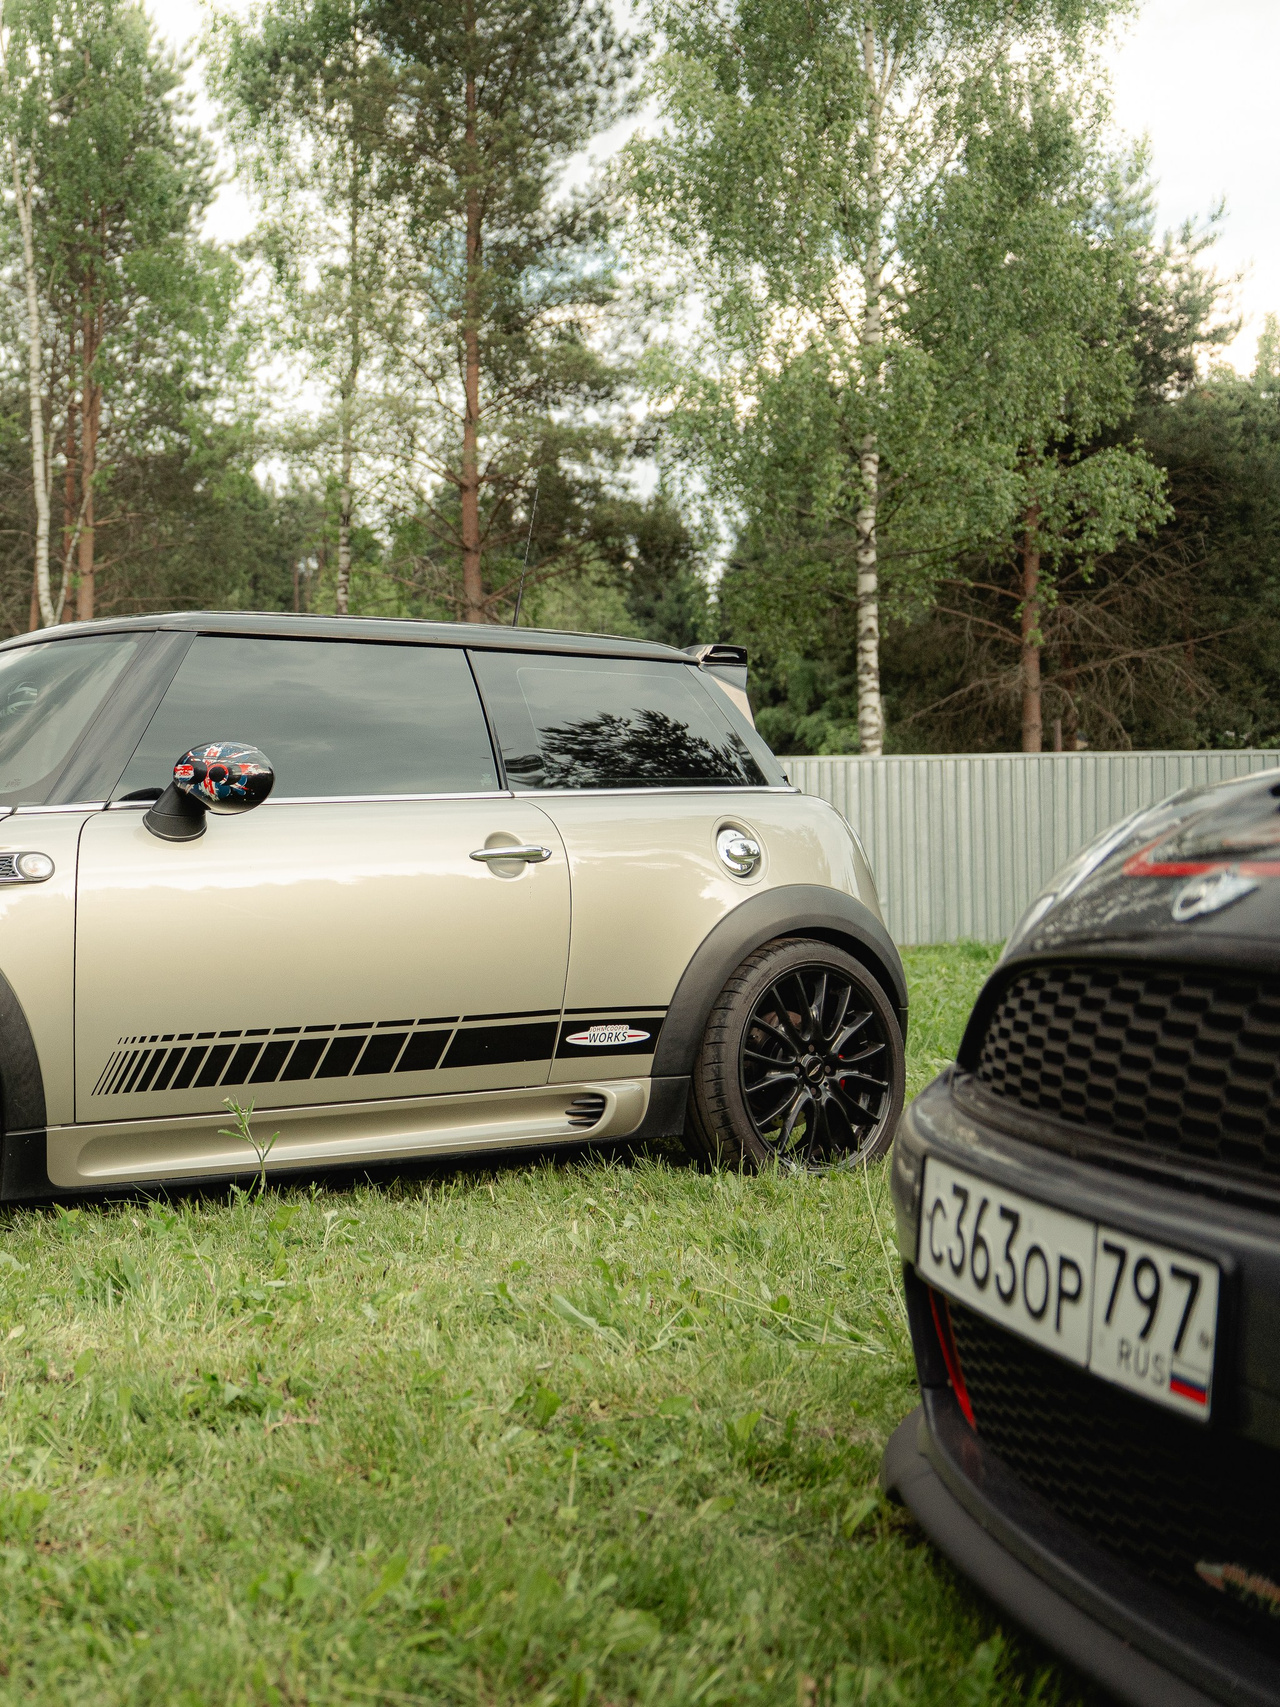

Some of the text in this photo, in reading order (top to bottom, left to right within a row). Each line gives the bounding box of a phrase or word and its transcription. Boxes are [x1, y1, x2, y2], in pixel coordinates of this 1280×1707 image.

[589, 1031, 627, 1043] WORKS
[1102, 1240, 1200, 1355] 797
[1118, 1338, 1166, 1387] RUS
